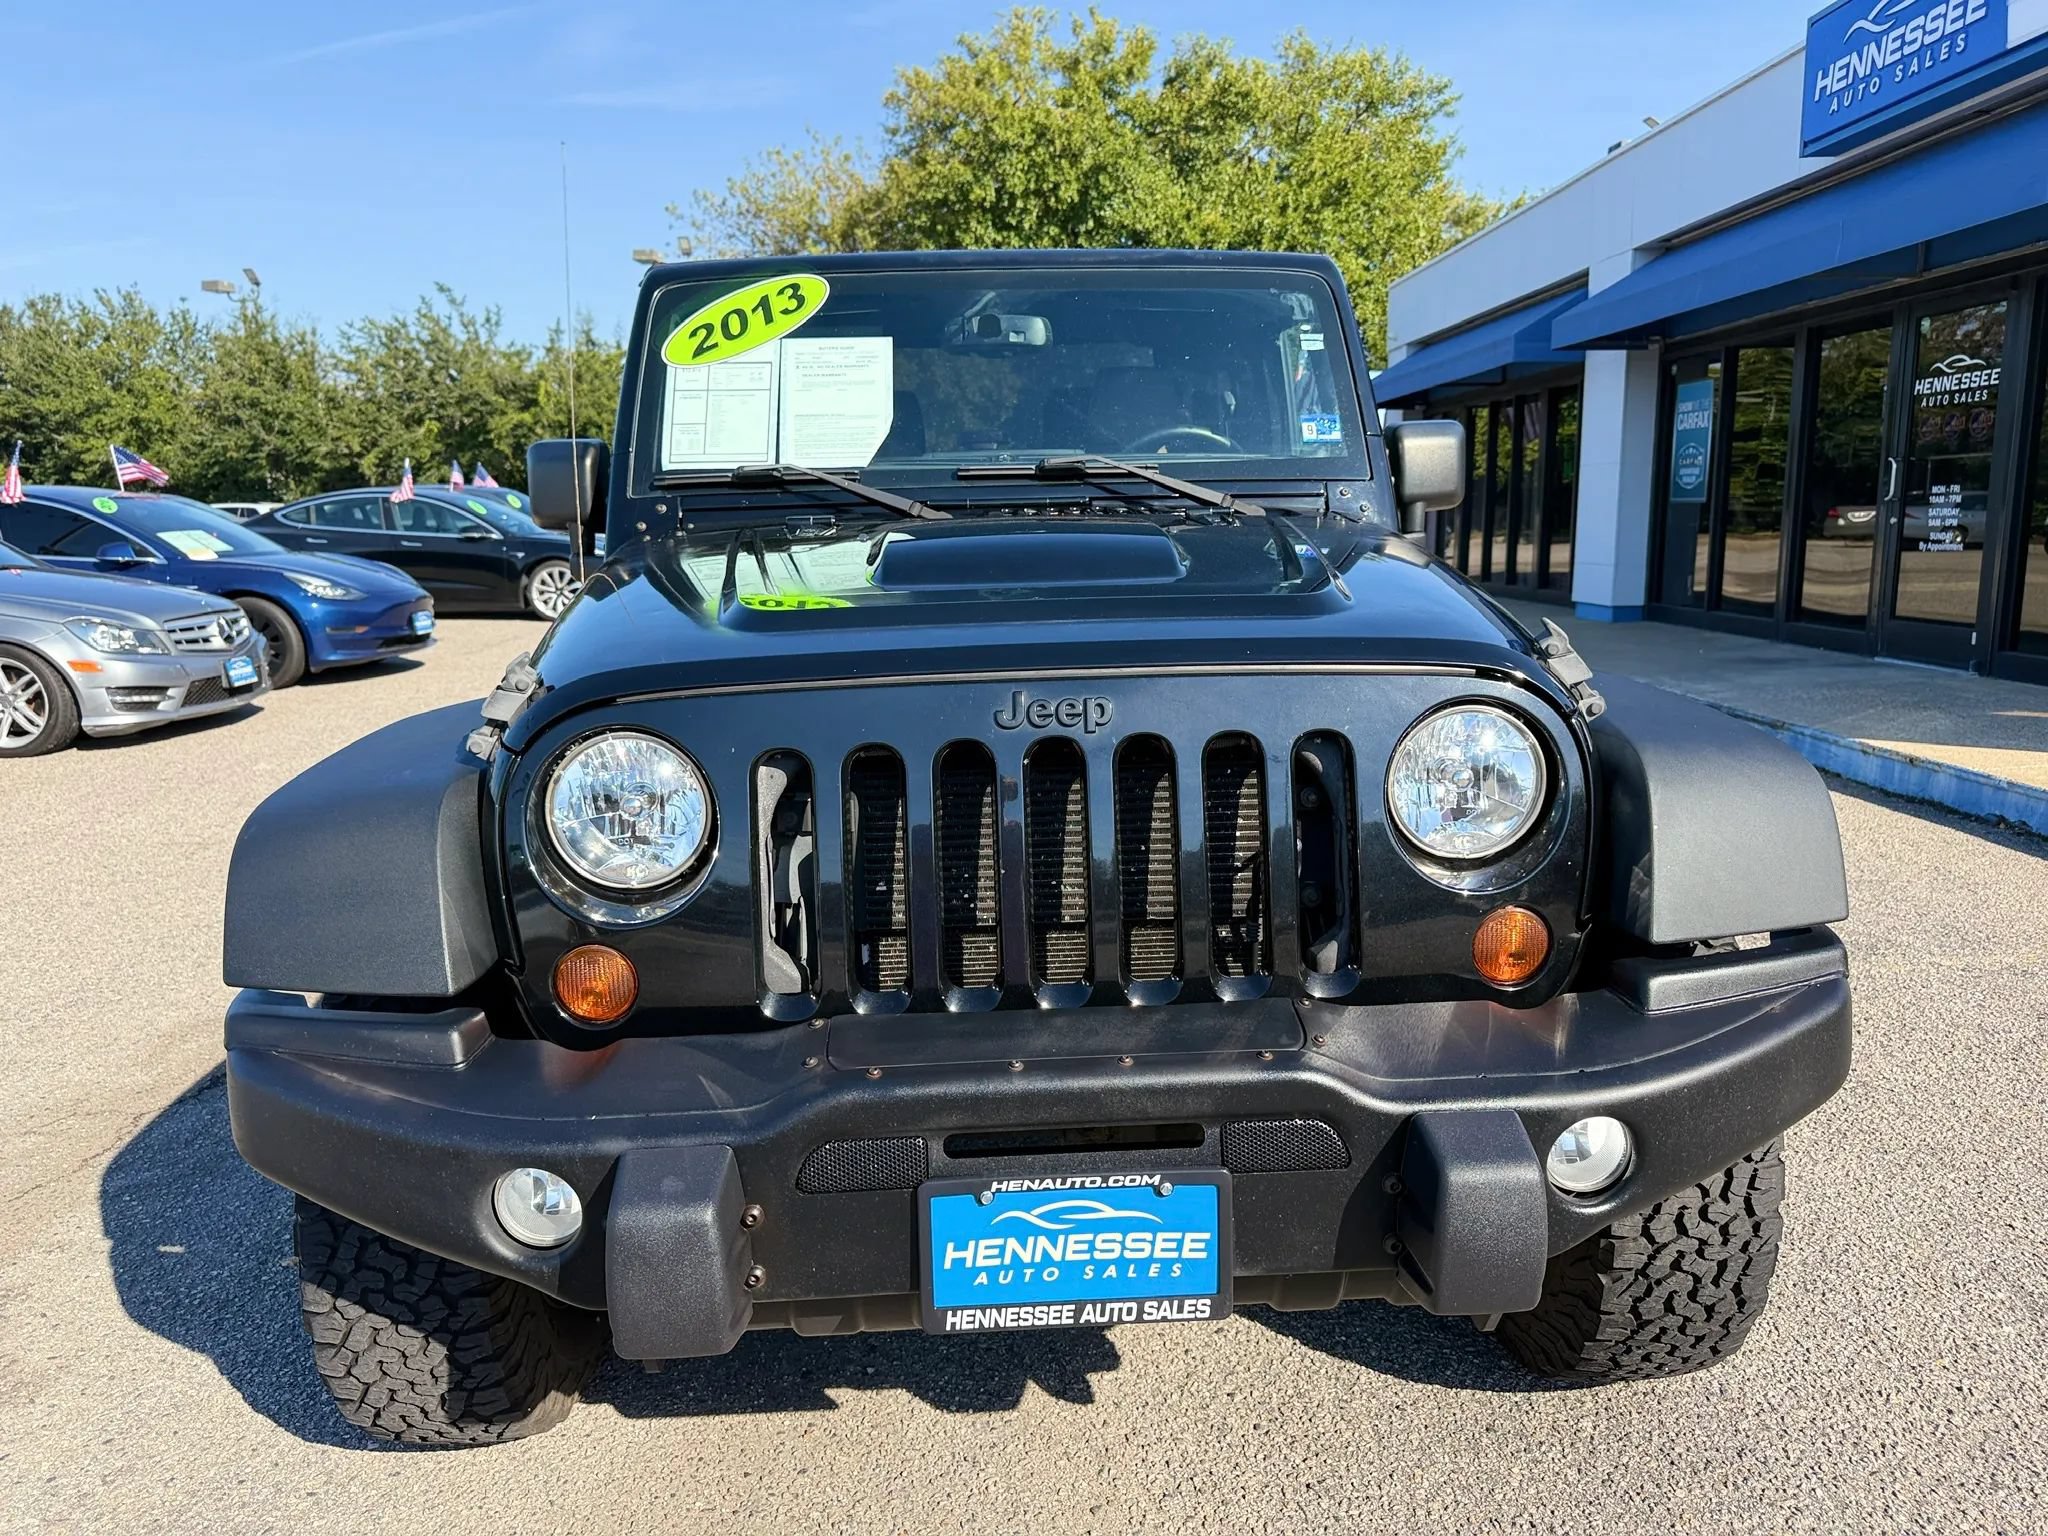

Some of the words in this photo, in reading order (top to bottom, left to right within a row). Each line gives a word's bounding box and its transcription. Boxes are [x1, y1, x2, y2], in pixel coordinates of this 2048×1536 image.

[1814, 0, 1988, 101] HENNESSEE
[1829, 78, 1880, 115] AUTO
[1895, 34, 1967, 82] SALES
[688, 283, 806, 360] 2013
[1914, 368, 2001, 395] HENNESSEE
[1921, 395, 1949, 407] AUTO
[1954, 390, 1988, 403] SALES
[1678, 410, 1710, 430] CARFAX
[1932, 485, 1946, 493] MON
[1950, 485, 1960, 493] FRI
[1949, 495, 1962, 503] 7PM
[1928, 508, 1960, 517] SATURDAY
[1930, 532, 1954, 540] SUNDAY
[993, 691, 1113, 734] Jeep
[991, 1174, 1161, 1192] HENAUTO.COM
[944, 1232, 1211, 1269] HENNESSEE
[973, 1267, 1060, 1285] AUTO
[1083, 1263, 1183, 1280] SALES
[946, 1304, 1075, 1331] HENNESSEE
[1079, 1302, 1137, 1324] AUTO
[1143, 1298, 1212, 1320] SALES
